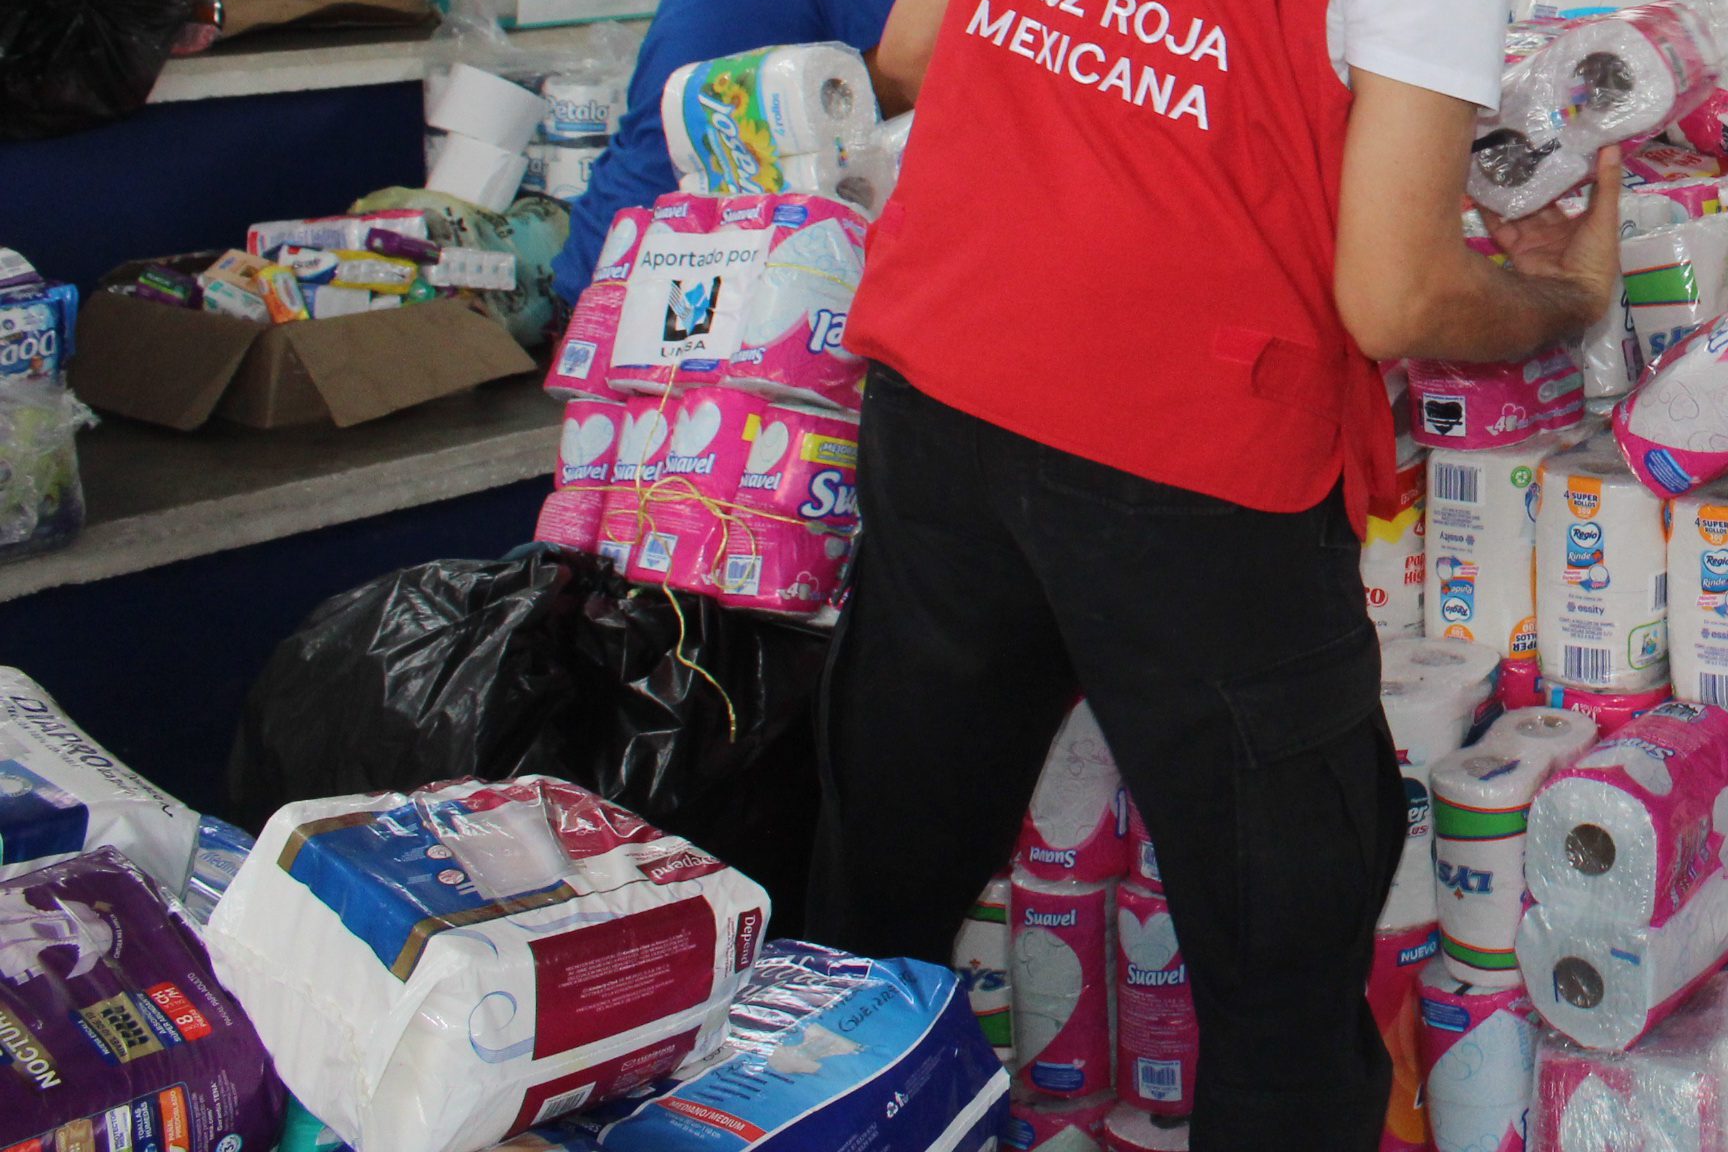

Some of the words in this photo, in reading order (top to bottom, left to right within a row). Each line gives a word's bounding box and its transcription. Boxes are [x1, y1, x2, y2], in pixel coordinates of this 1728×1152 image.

[699, 94, 760, 193] rasol
[721, 206, 762, 225] Suavel
[640, 247, 723, 269] Aportado
[727, 248, 760, 265] por
[612, 459, 663, 483] Suavel
[664, 450, 716, 475] Suavel
[562, 462, 607, 484] Suavel
[739, 470, 782, 490] Suavel
[1571, 492, 1598, 503] SUPER
[1702, 519, 1728, 529] SUPER
[1573, 528, 1599, 541] Regio
[1568, 551, 1591, 562] Rinde
[1451, 584, 1472, 594] Rinde
[1702, 577, 1726, 587] Rinde
[1445, 605, 1470, 617] Regio
[1577, 603, 1605, 615] essity
[651, 851, 721, 881] Depend
[1030, 846, 1076, 868] Suavel
[1437, 859, 1494, 895] LYS
[1024, 908, 1077, 928] Suavel
[739, 915, 756, 965] Depend
[1400, 940, 1437, 962] NUEVO
[176, 1014, 194, 1026] 8
[670, 1099, 745, 1132] MEDIANO/MEDIUM
